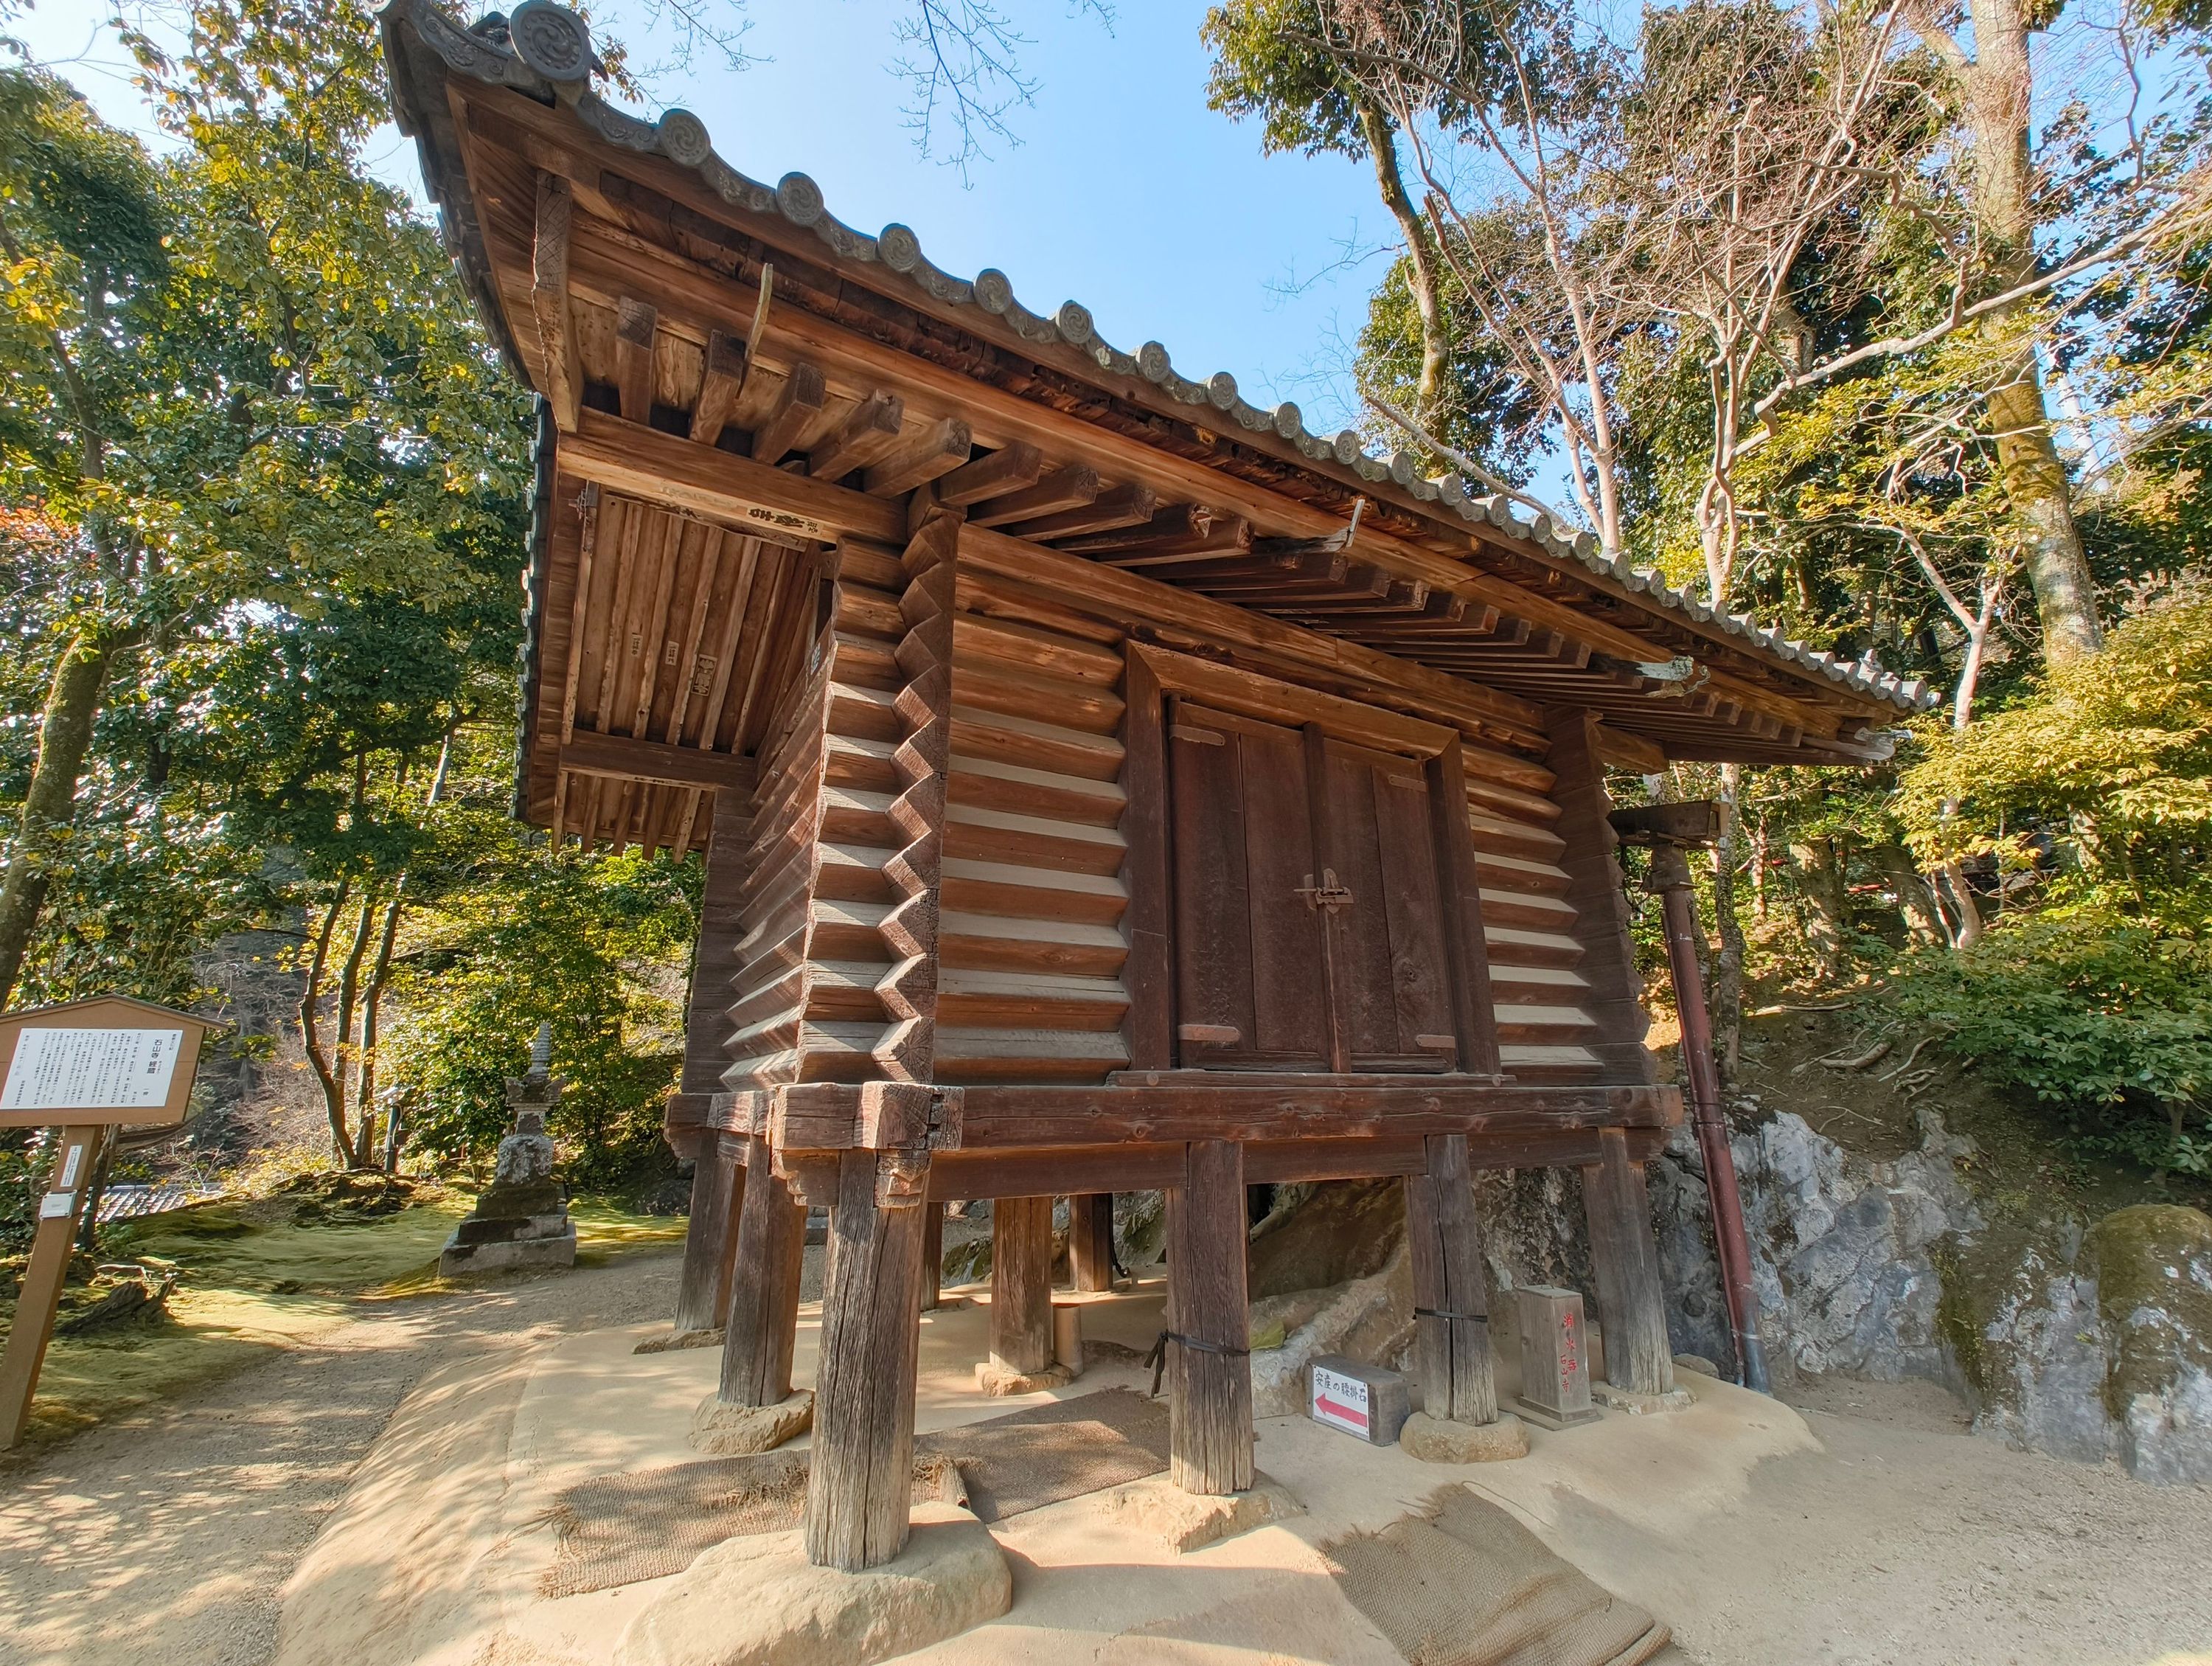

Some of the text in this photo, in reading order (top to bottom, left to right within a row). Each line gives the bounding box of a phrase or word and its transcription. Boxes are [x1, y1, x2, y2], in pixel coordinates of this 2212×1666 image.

[151, 1039, 163, 1059] 石山寺
[1315, 1370, 1366, 1402] 安産の腰掛石
[1560, 1354, 1569, 1392] 石山寺
